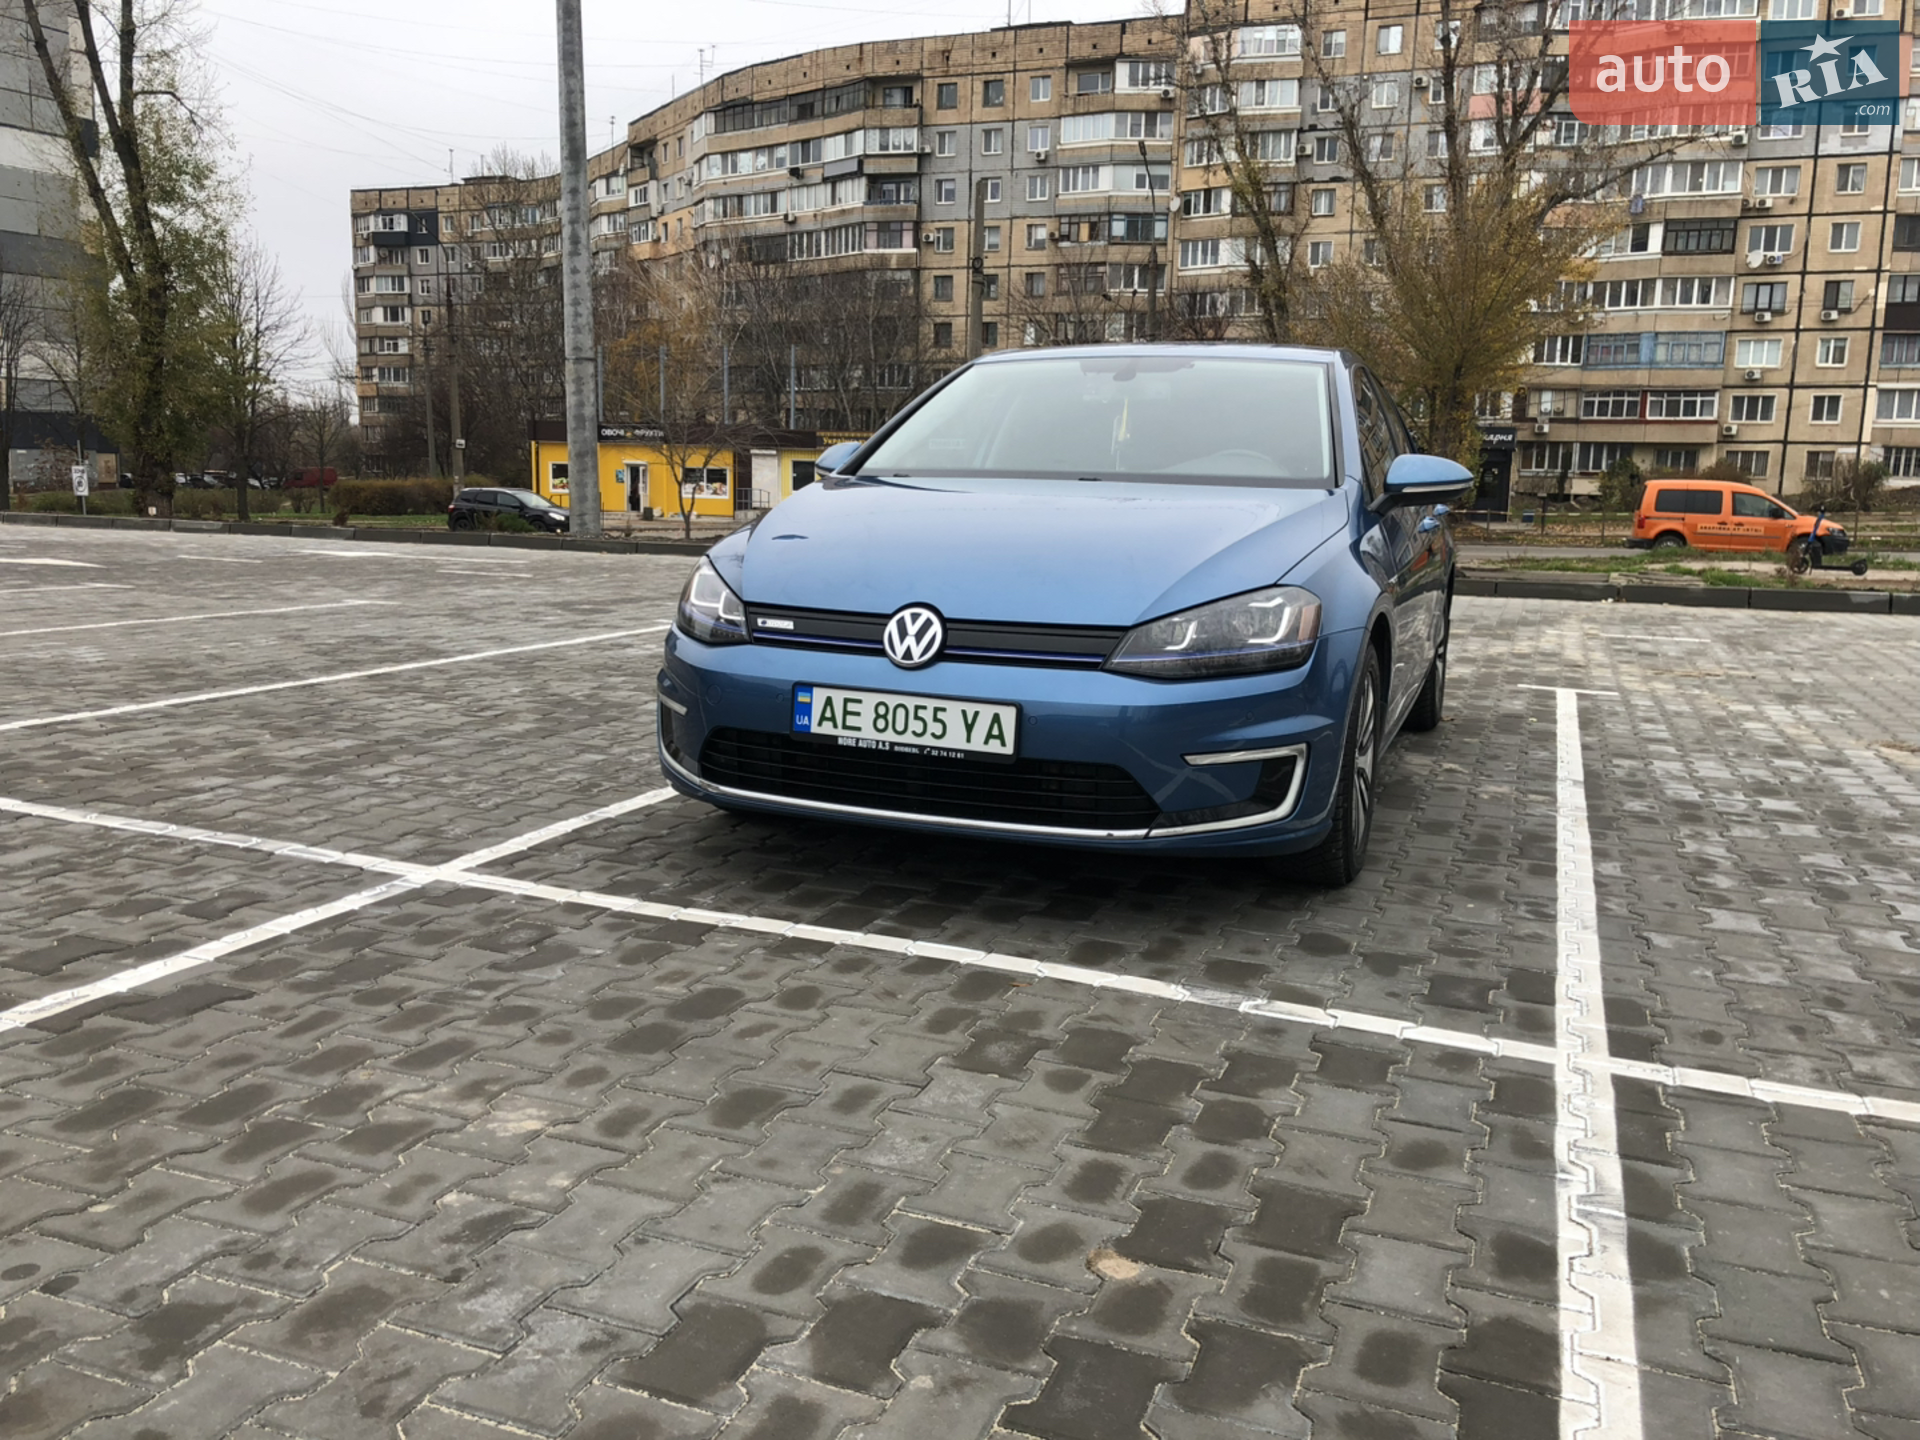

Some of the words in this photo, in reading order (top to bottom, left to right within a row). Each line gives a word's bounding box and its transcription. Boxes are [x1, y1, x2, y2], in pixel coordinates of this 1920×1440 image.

[796, 714, 810, 726] UA
[816, 695, 863, 732] AE
[872, 700, 948, 740] 8055
[960, 708, 1007, 747] YA
[858, 739, 877, 749] AUTO
